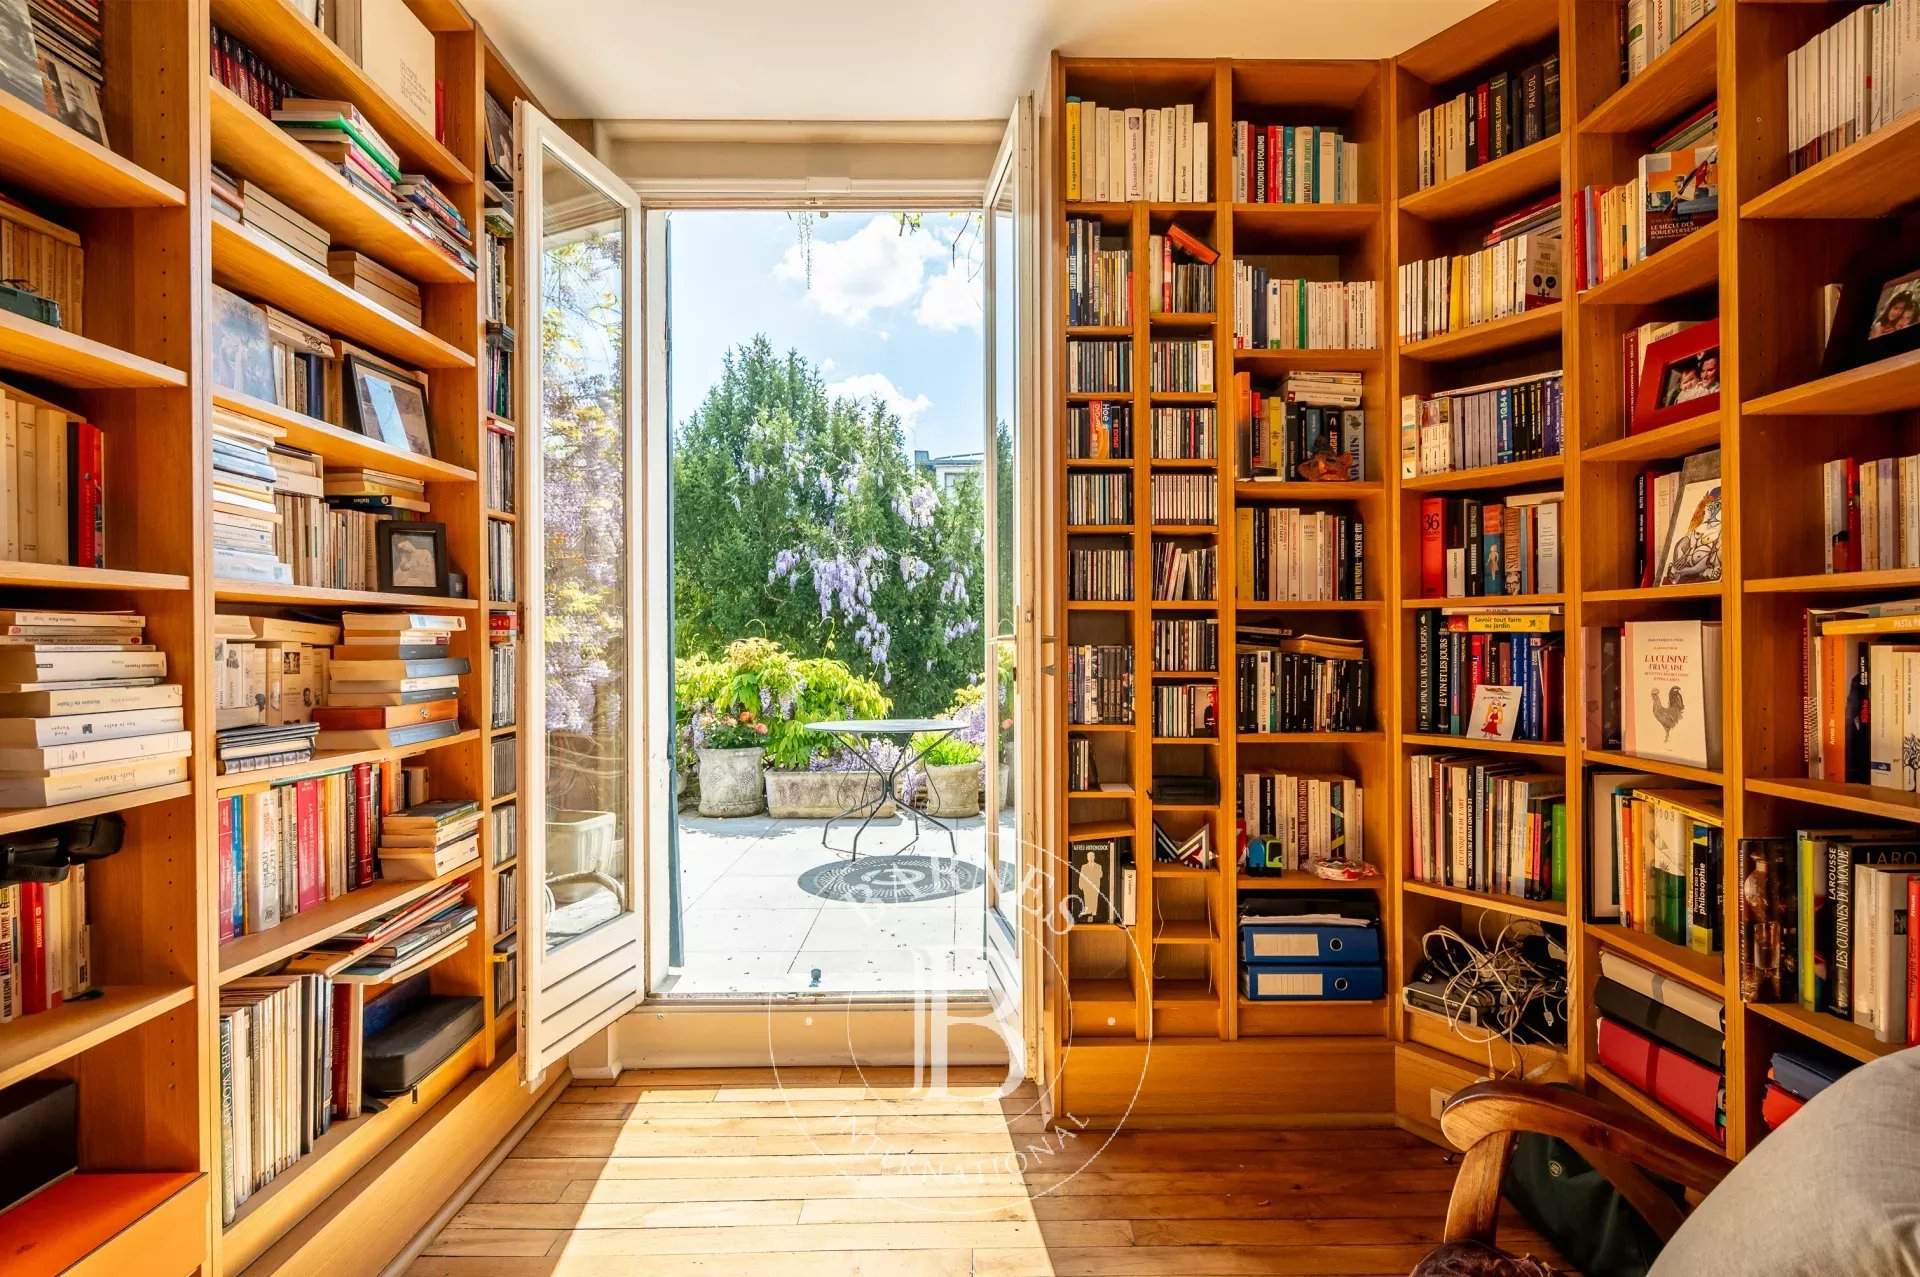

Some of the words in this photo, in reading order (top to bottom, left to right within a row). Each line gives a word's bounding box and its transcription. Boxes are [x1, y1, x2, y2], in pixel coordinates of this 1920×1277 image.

[1528, 74, 1536, 109] PANCOL
[1424, 513, 1440, 530] 36
[1440, 638, 1448, 660] JOURS
[1649, 663, 1684, 672] FRANÇAISE
[1657, 655, 1688, 663] CUISINE
[1440, 673, 1448, 682] ET
[1440, 698, 1448, 707] LE
[1829, 848, 1837, 900] LAROUSSE
[1836, 850, 1848, 886] MONDE
[1699, 863, 1708, 916] philosophie
[1836, 888, 1848, 904] DU
[1836, 906, 1848, 948] CUISINES
[1836, 951, 1848, 968] LES
[220, 1033, 232, 1073] TIGER
